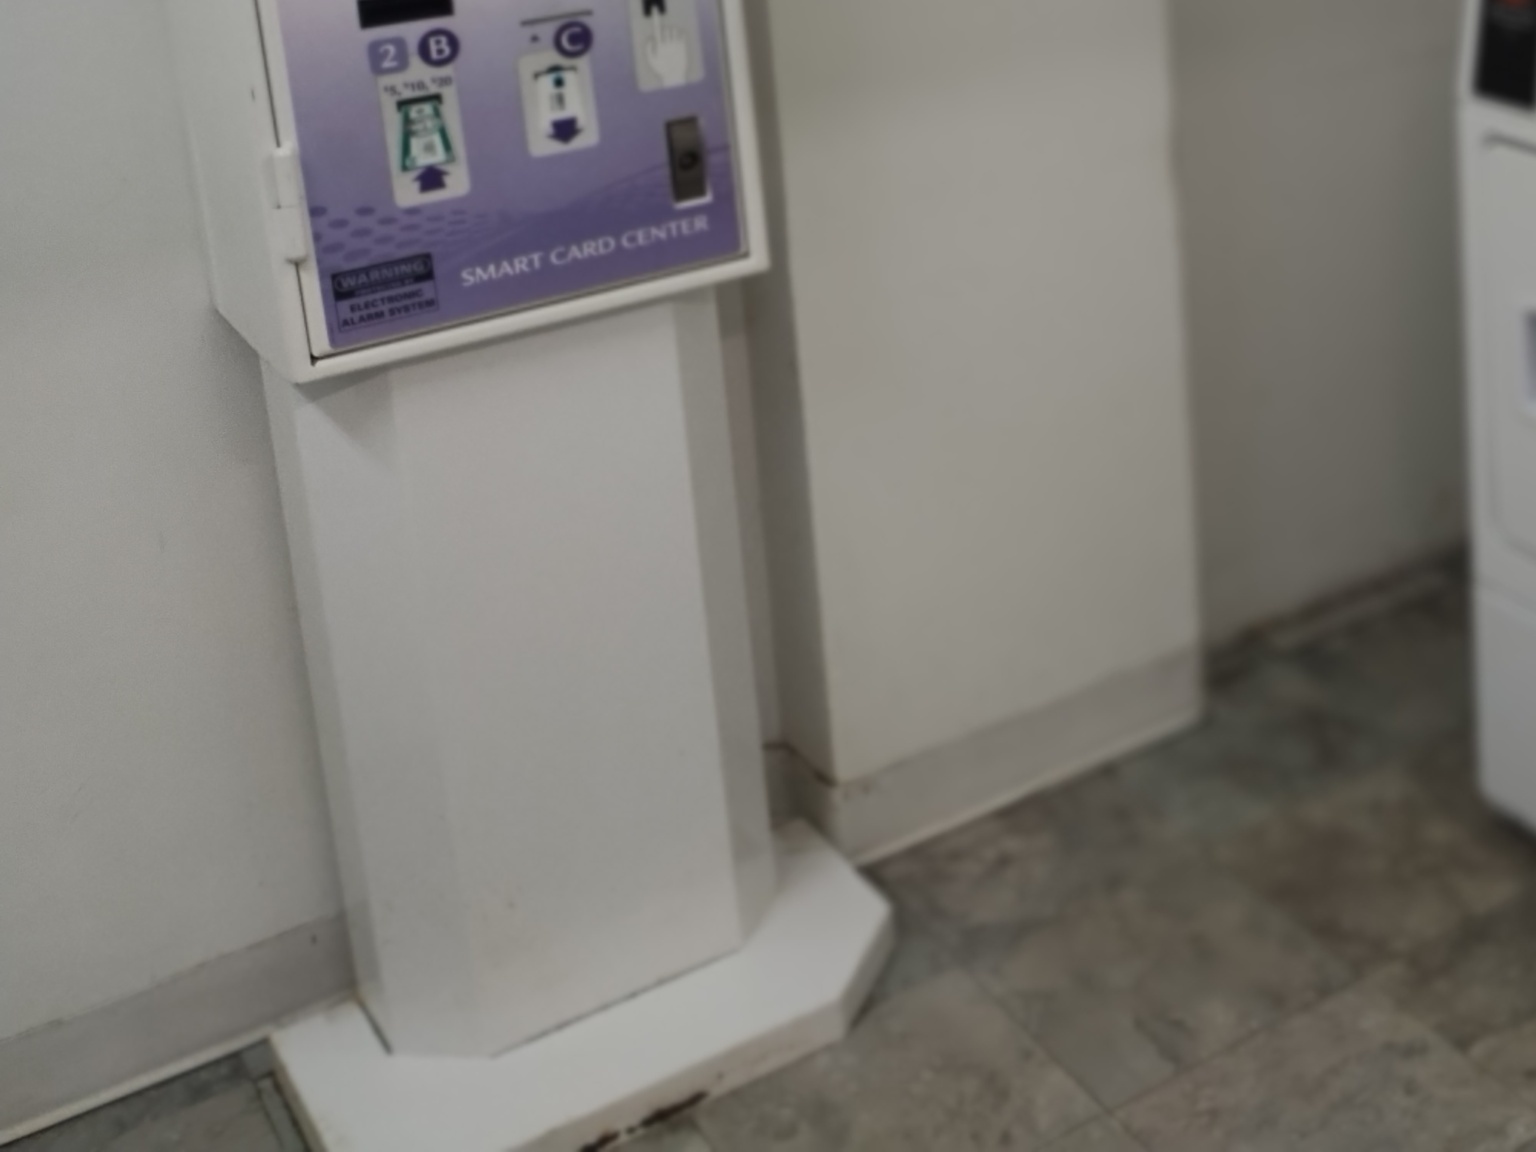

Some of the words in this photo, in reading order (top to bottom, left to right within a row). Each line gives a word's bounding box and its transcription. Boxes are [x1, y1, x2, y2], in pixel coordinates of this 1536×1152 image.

[379, 44, 398, 69] 2
[429, 34, 451, 61] B
[560, 26, 586, 53] C
[461, 252, 544, 287] SMART
[551, 235, 616, 266] CARD
[621, 214, 710, 248] CENTER
[338, 262, 425, 289] WARNING
[342, 309, 385, 327] ALARM
[388, 298, 436, 318] SYSTEM
[349, 289, 424, 314] ELECTRONIC
